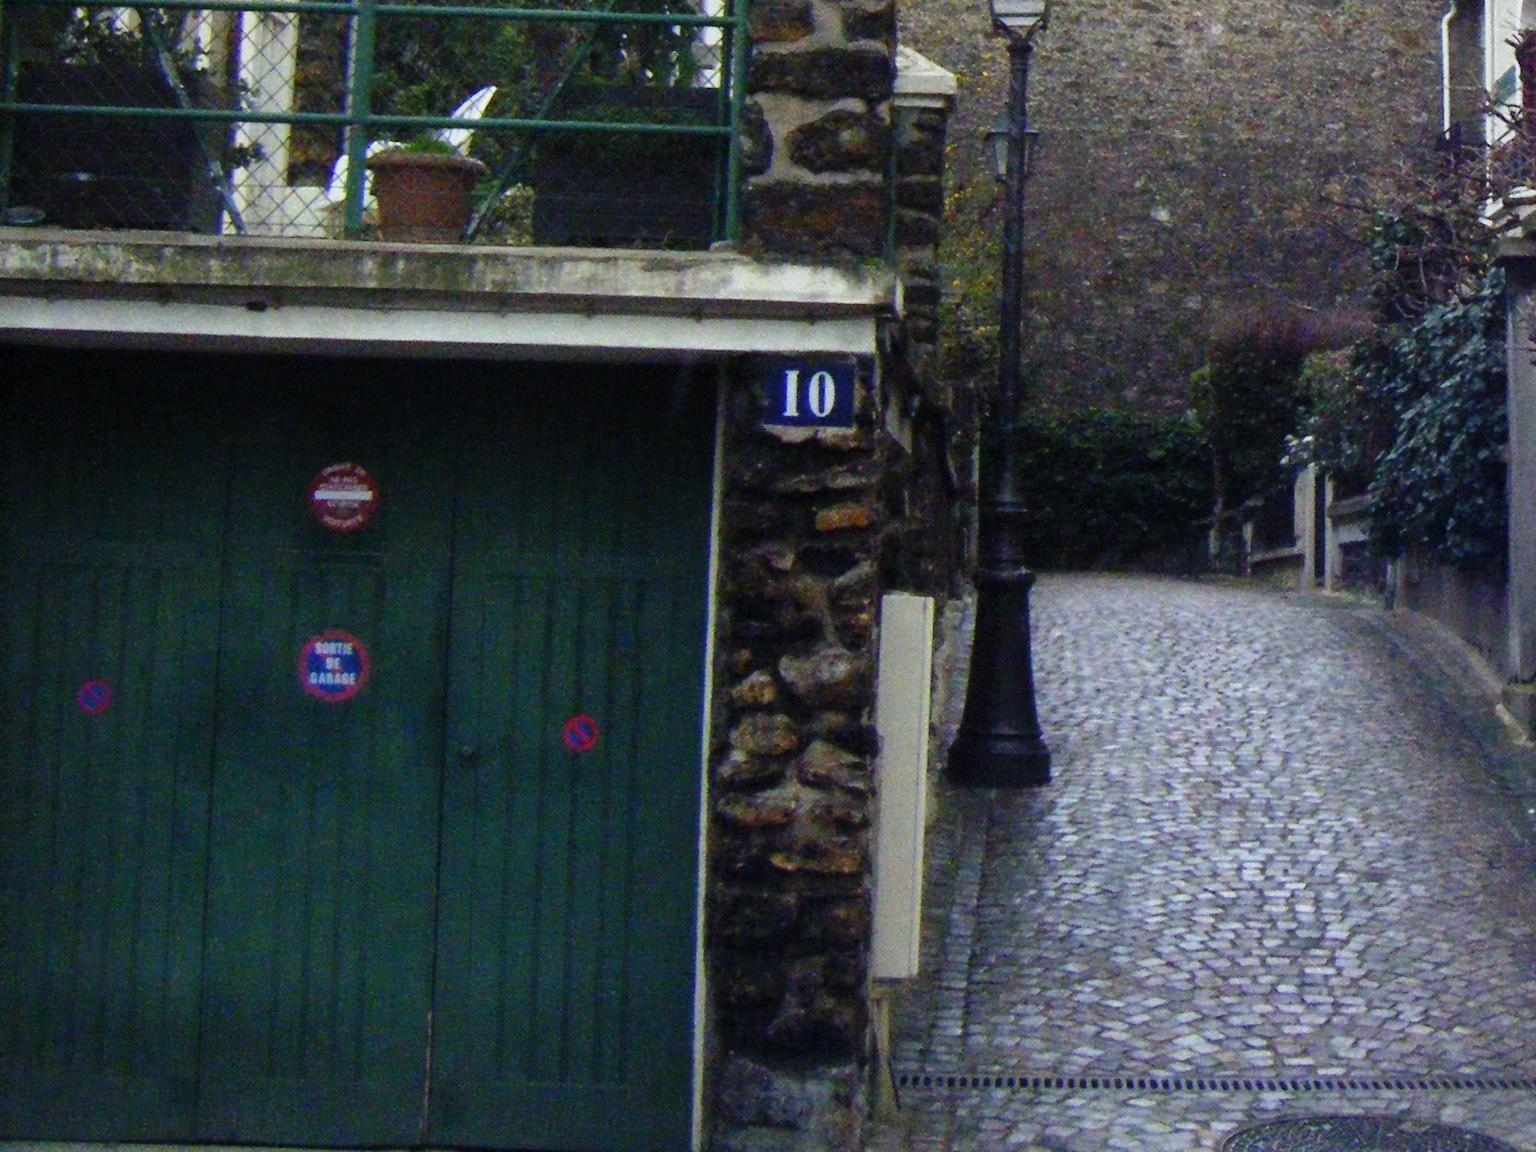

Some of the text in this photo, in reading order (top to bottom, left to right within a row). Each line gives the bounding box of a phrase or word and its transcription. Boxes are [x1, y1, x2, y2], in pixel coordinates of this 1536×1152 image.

[782, 369, 836, 418] 10
[314, 641, 353, 656] SORTIE
[326, 657, 342, 670] DE
[309, 671, 358, 686] GARAGE
